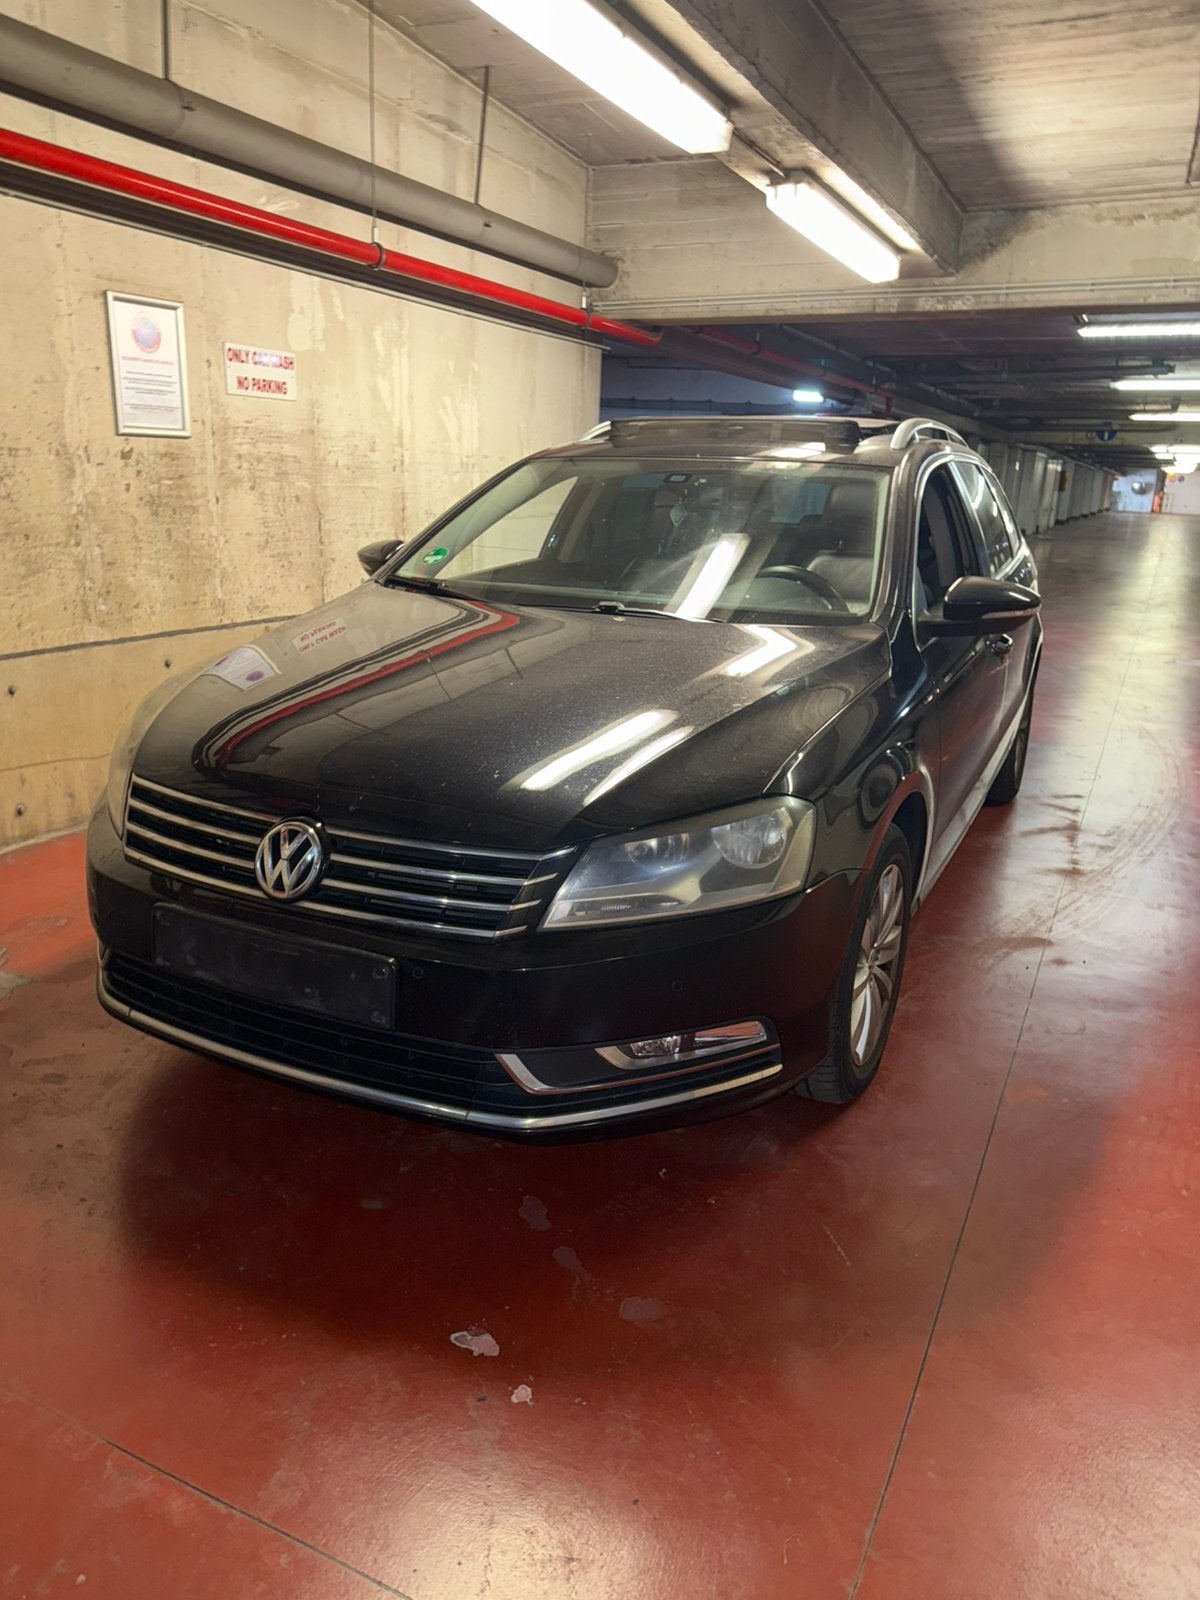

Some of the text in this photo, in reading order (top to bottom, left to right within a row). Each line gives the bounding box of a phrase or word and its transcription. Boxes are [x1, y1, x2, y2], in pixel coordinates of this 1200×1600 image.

[227, 347, 250, 364] ONLY
[236, 375, 288, 395] NO PARKING
[260, 824, 319, 897] VW
